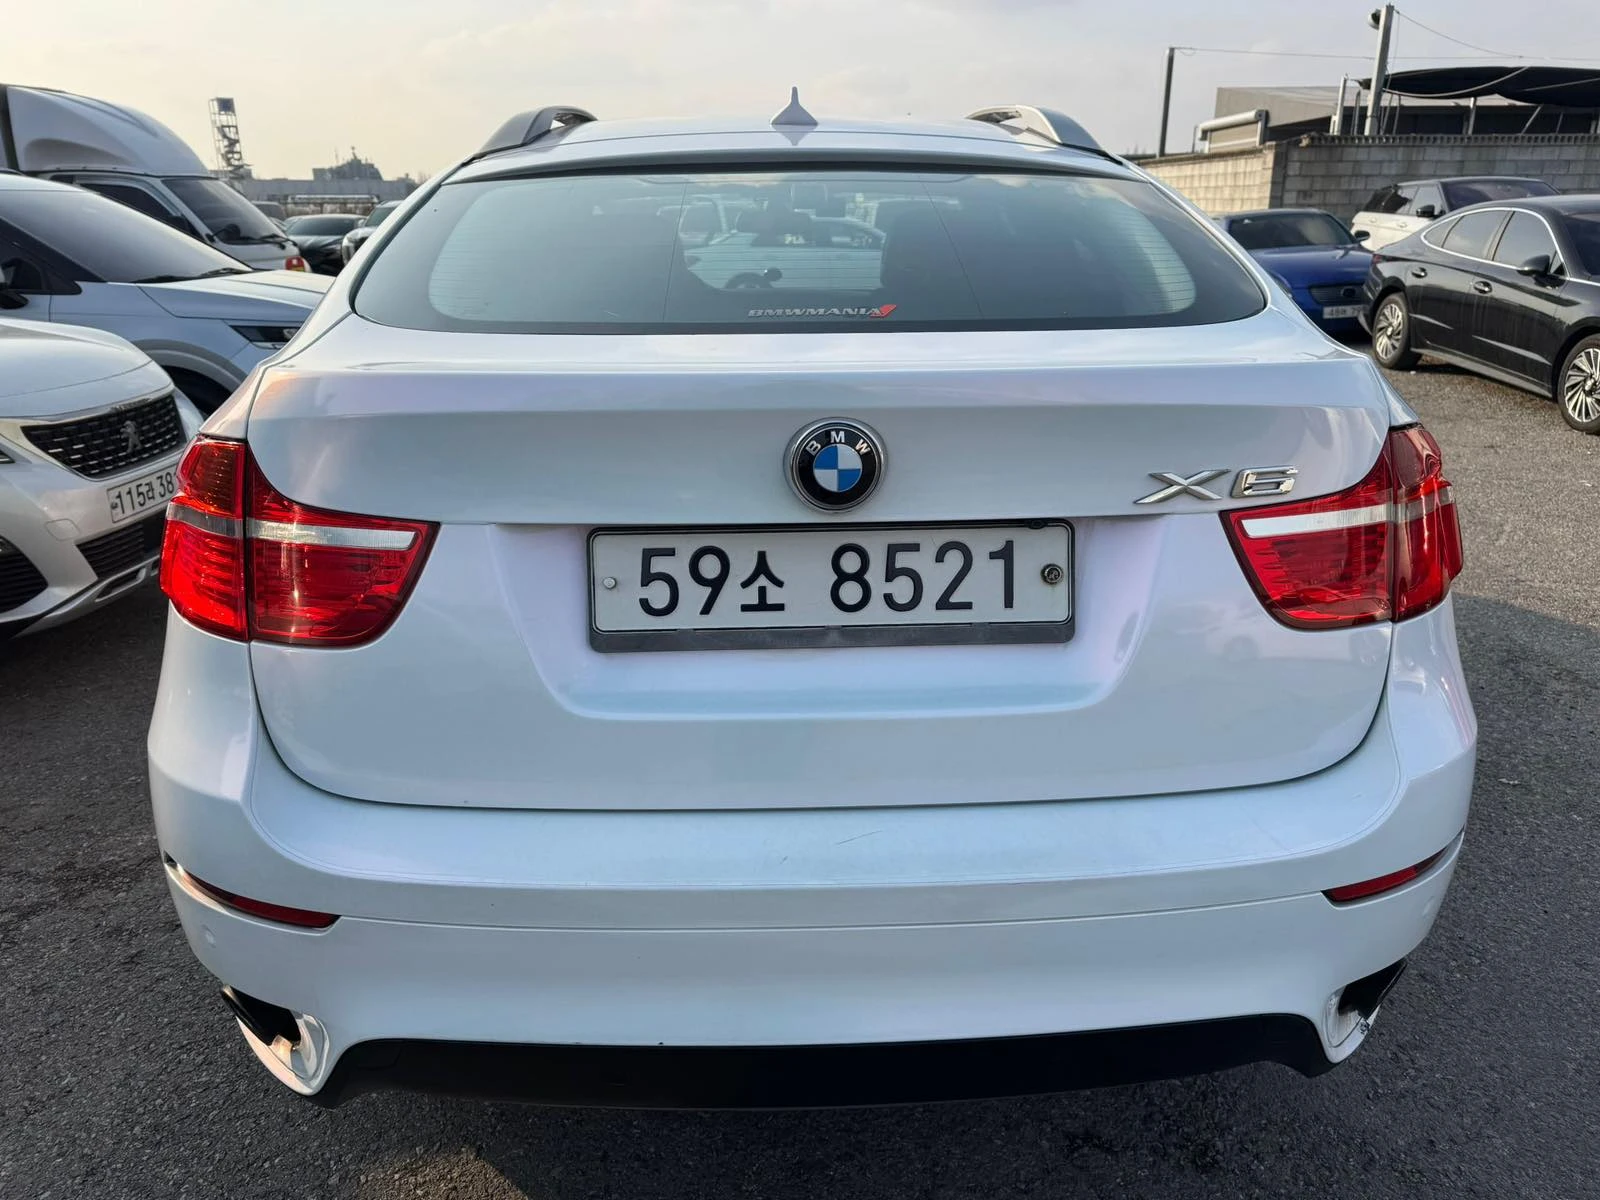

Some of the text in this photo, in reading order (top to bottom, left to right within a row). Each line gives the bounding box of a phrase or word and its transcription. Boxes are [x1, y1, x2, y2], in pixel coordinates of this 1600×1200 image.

[748, 306, 882, 317] BMWMANIA
[805, 430, 871, 456] BMW
[156, 471, 178, 498] 38
[1133, 465, 1298, 504] X6
[638, 540, 1014, 617] 59소 8521
